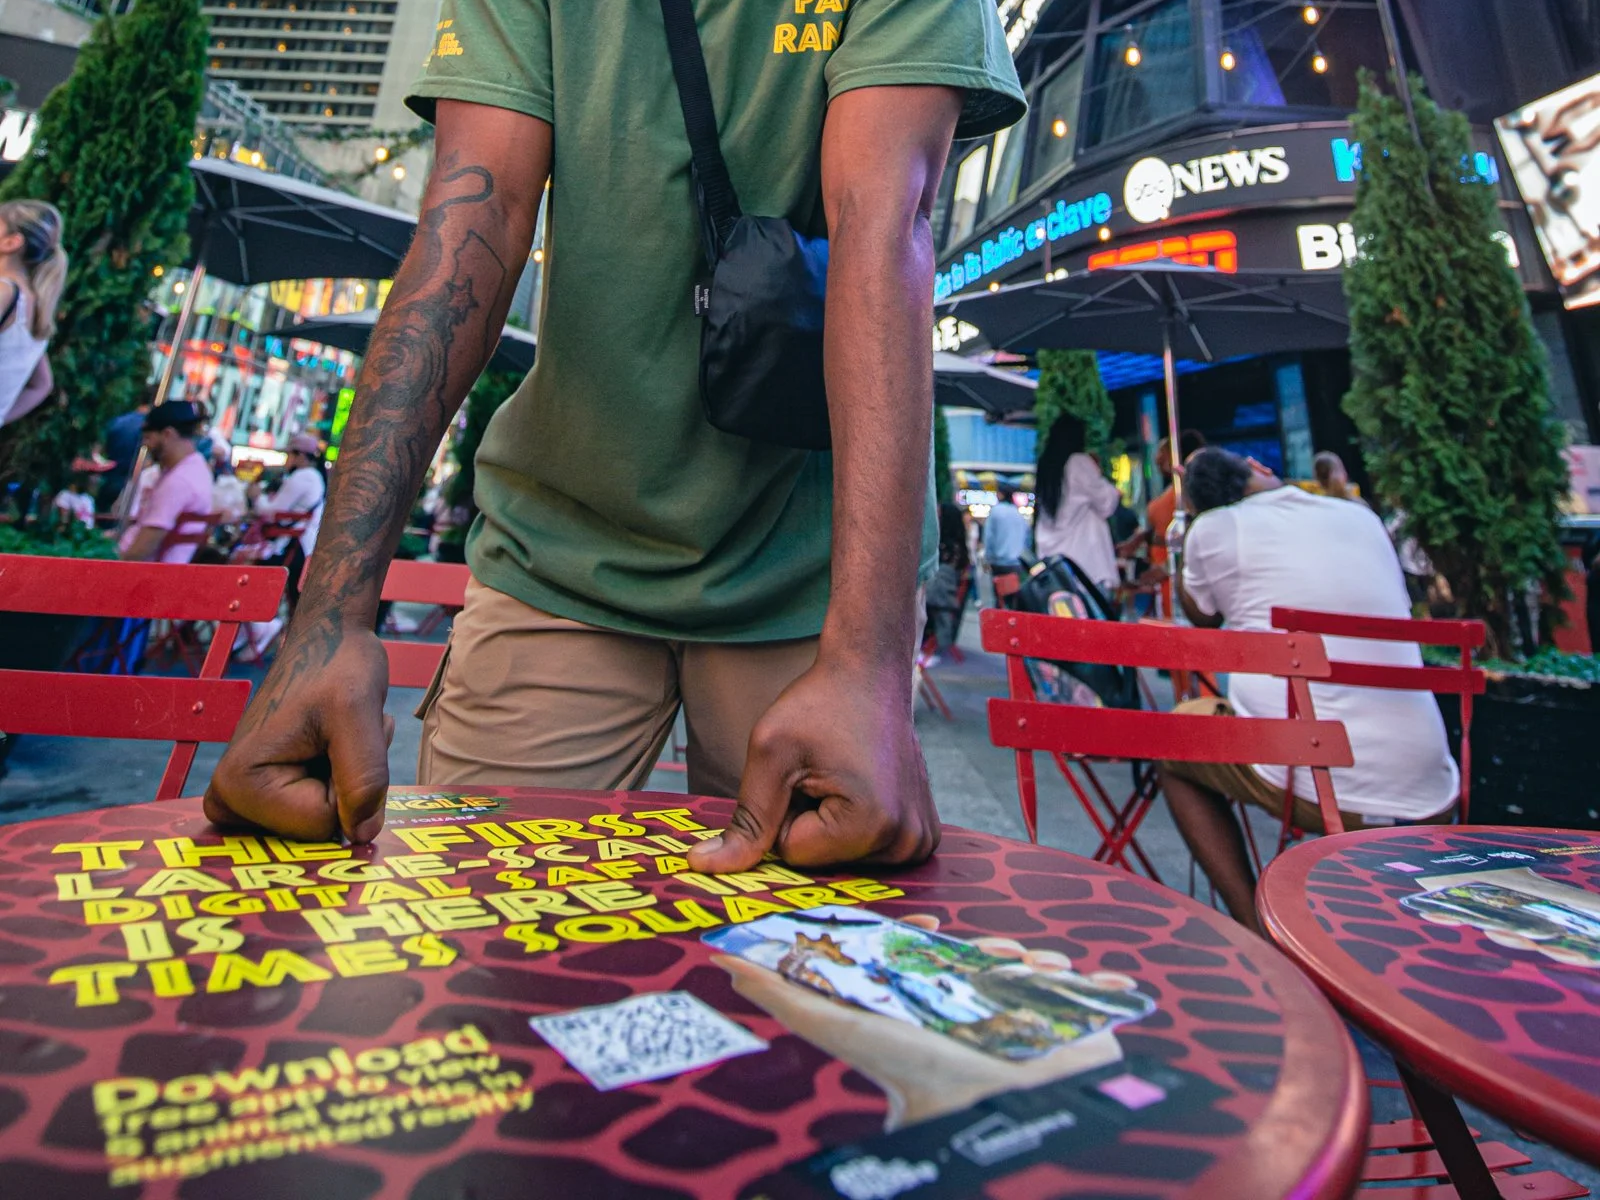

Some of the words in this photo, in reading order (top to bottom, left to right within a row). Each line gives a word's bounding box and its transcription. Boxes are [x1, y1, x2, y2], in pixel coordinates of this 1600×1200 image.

[1170, 146, 1290, 198] NEWS
[52, 836, 352, 871] THE
[392, 808, 708, 853] FIRST
[84, 877, 471, 926] DIGITAL
[496, 853, 779, 890] SAFA
[121, 917, 244, 962] IS
[302, 880, 658, 943] HERE
[672, 863, 815, 896] IN
[49, 933, 460, 1007] TIMES
[504, 878, 905, 953] SQUARE
[93, 1024, 490, 1115] Download
